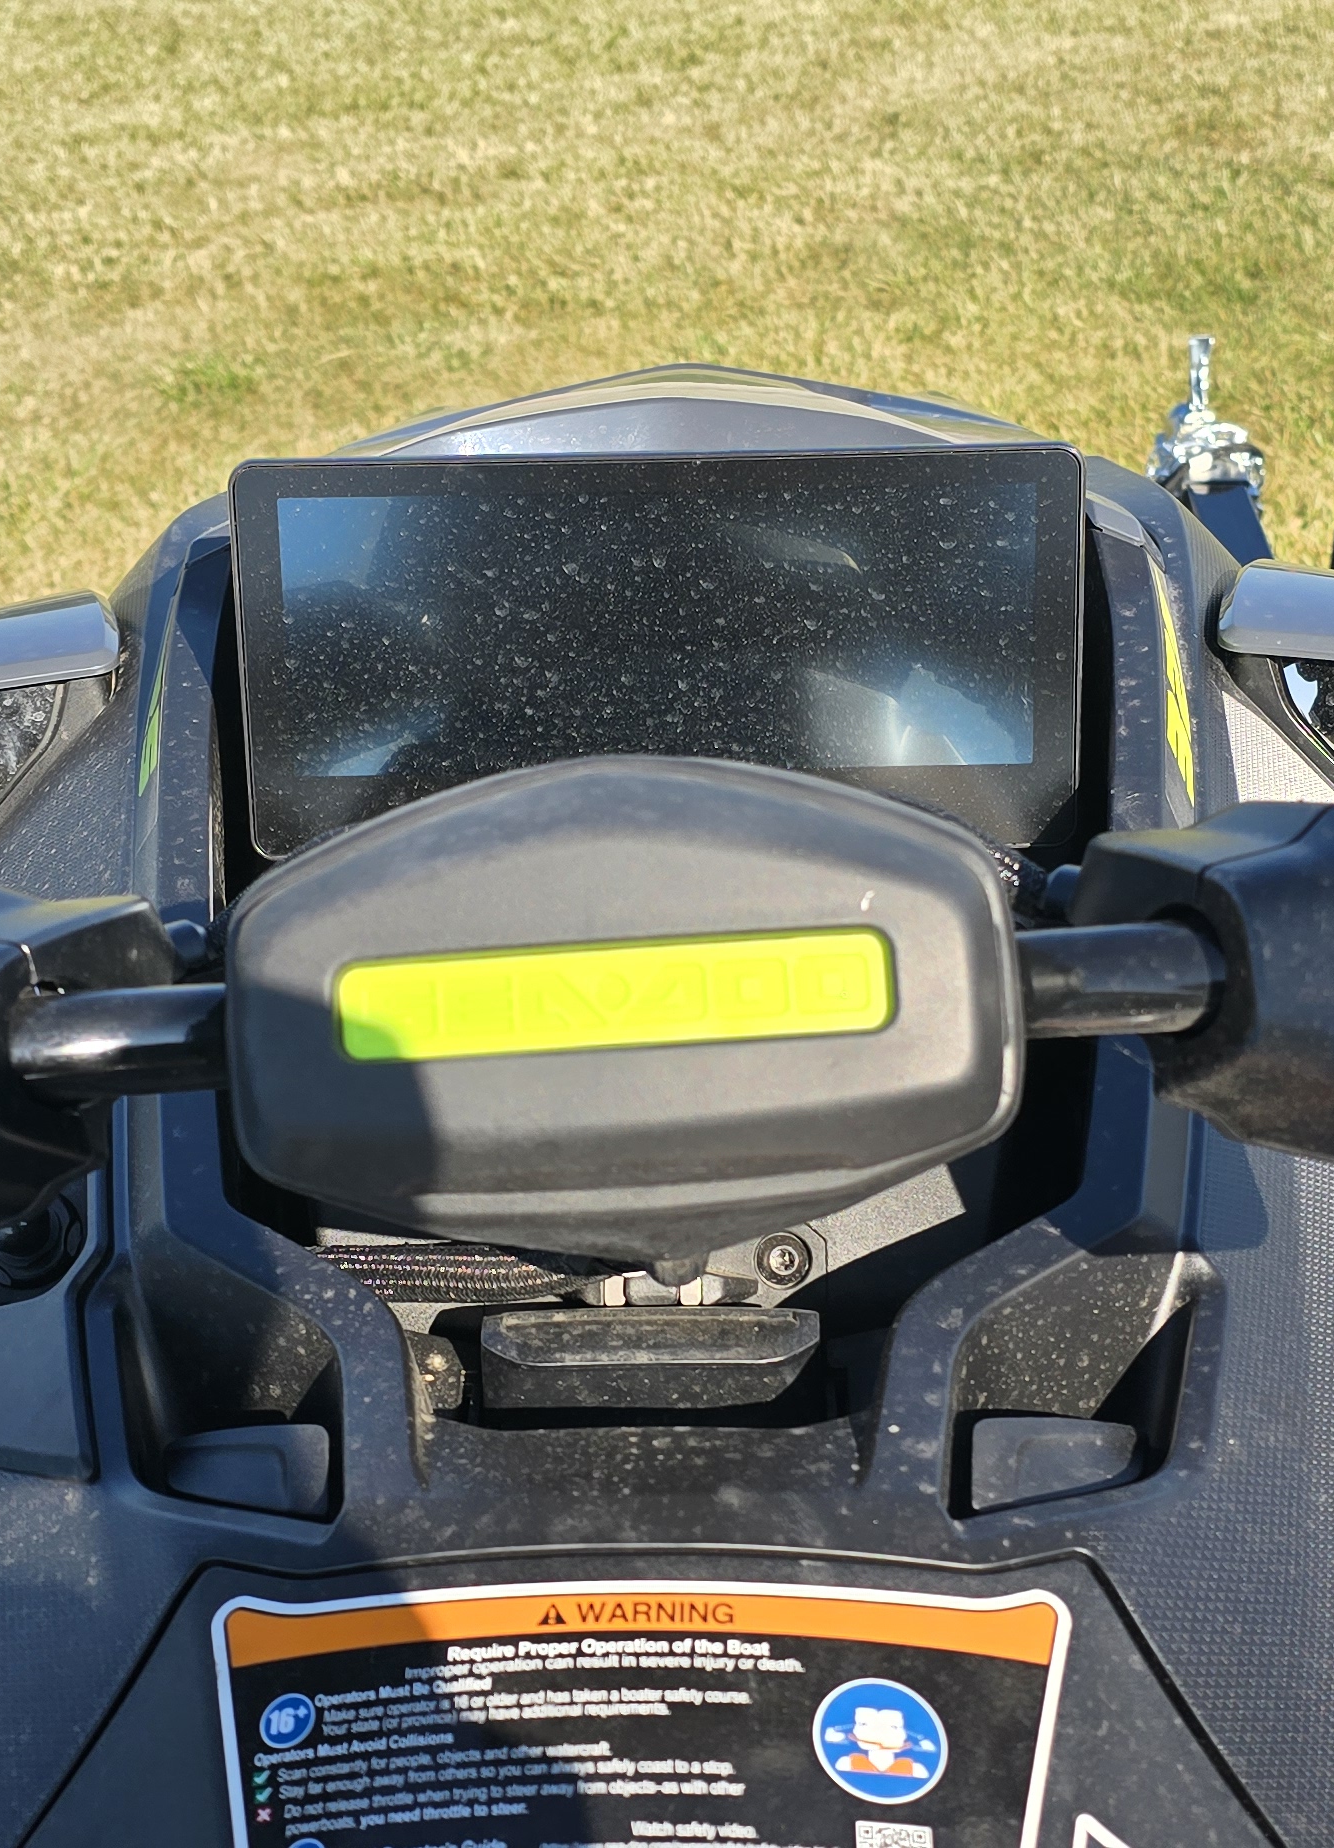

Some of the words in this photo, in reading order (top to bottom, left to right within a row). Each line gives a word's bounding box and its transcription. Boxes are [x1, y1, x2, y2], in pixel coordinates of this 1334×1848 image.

[576, 1601, 735, 1625] WARNING
[447, 1643, 516, 1662] Require
[518, 1640, 579, 1658] Proper
[581, 1638, 670, 1656] Operation
[671, 1638, 693, 1654] of
[694, 1638, 725, 1655] the
[726, 1639, 771, 1657] Boat
[404, 1662, 471, 1680] Improper
[472, 1656, 544, 1676] operation
[544, 1656, 575, 1670] can
[576, 1653, 620, 1669] result
[621, 1653, 637, 1668] in
[638, 1654, 692, 1669] severe
[693, 1653, 736, 1672] injury
[737, 1656, 756, 1670] or
[756, 1657, 806, 1673] death.
[315, 1689, 376, 1708] Operators
[378, 1684, 410, 1699] Must
[412, 1682, 430, 1696] Be
[432, 1676, 493, 1695] Qualified
[323, 1708, 357, 1723] Make
[358, 1705, 384, 1719] sure
[386, 1700, 437, 1717] operator
[469, 1695, 485, 1708] or
[485, 1691, 519, 1706] older
[519, 1689, 546, 1705] and
[546, 1688, 571, 1703] has
[572, 1688, 609, 1702] taken
[609, 1690, 619, 1702] a
[620, 1687, 663, 1702] boater
[664, 1687, 704, 1705] safety
[322, 1722, 348, 1736] Your
[350, 1718, 380, 1733] state
[458, 1709, 488, 1725] may
[488, 1705, 520, 1720] have
[253, 1747, 315, 1767] Operators
[316, 1742, 349, 1757] Must
[349, 1736, 388, 1754] Avoid
[388, 1732, 455, 1750] Collisions
[276, 1767, 307, 1783] Scan
[308, 1760, 368, 1778] constantly
[370, 1756, 388, 1770] for
[435, 1750, 482, 1766] objects
[483, 1746, 508, 1760] and
[509, 1743, 544, 1759] other
[278, 1784, 306, 1801] Stay
[307, 1781, 324, 1795] far
[324, 1776, 371, 1794] enough
[372, 1772, 406, 1789] away
[407, 1769, 436, 1784] from
[437, 1766, 479, 1782] others
[479, 1765, 496, 1778] so
[497, 1764, 522, 1781] you
[523, 1761, 548, 1775] can
[549, 1758, 596, 1777] always
[596, 1757, 636, 1777] safely
[636, 1758, 675, 1774] coast
[674, 1758, 690, 1774] to
[689, 1761, 702, 1774] a
[284, 1803, 302, 1819] Do
[303, 1801, 324, 1816] not
[416, 1788, 450, 1803] when
[452, 1785, 488, 1802] trying
[489, 1784, 504, 1798] to
[504, 1782, 539, 1798] steer
[539, 1782, 576, 1799] away
[709, 1778, 747, 1796] other
[359, 1813, 386, 1831] you
[386, 1807, 421, 1825] need
[422, 1803, 472, 1821] throttle
[473, 1802, 489, 1817] to
[630, 1820, 675, 1837] Watch
[675, 1820, 717, 1841] safety
